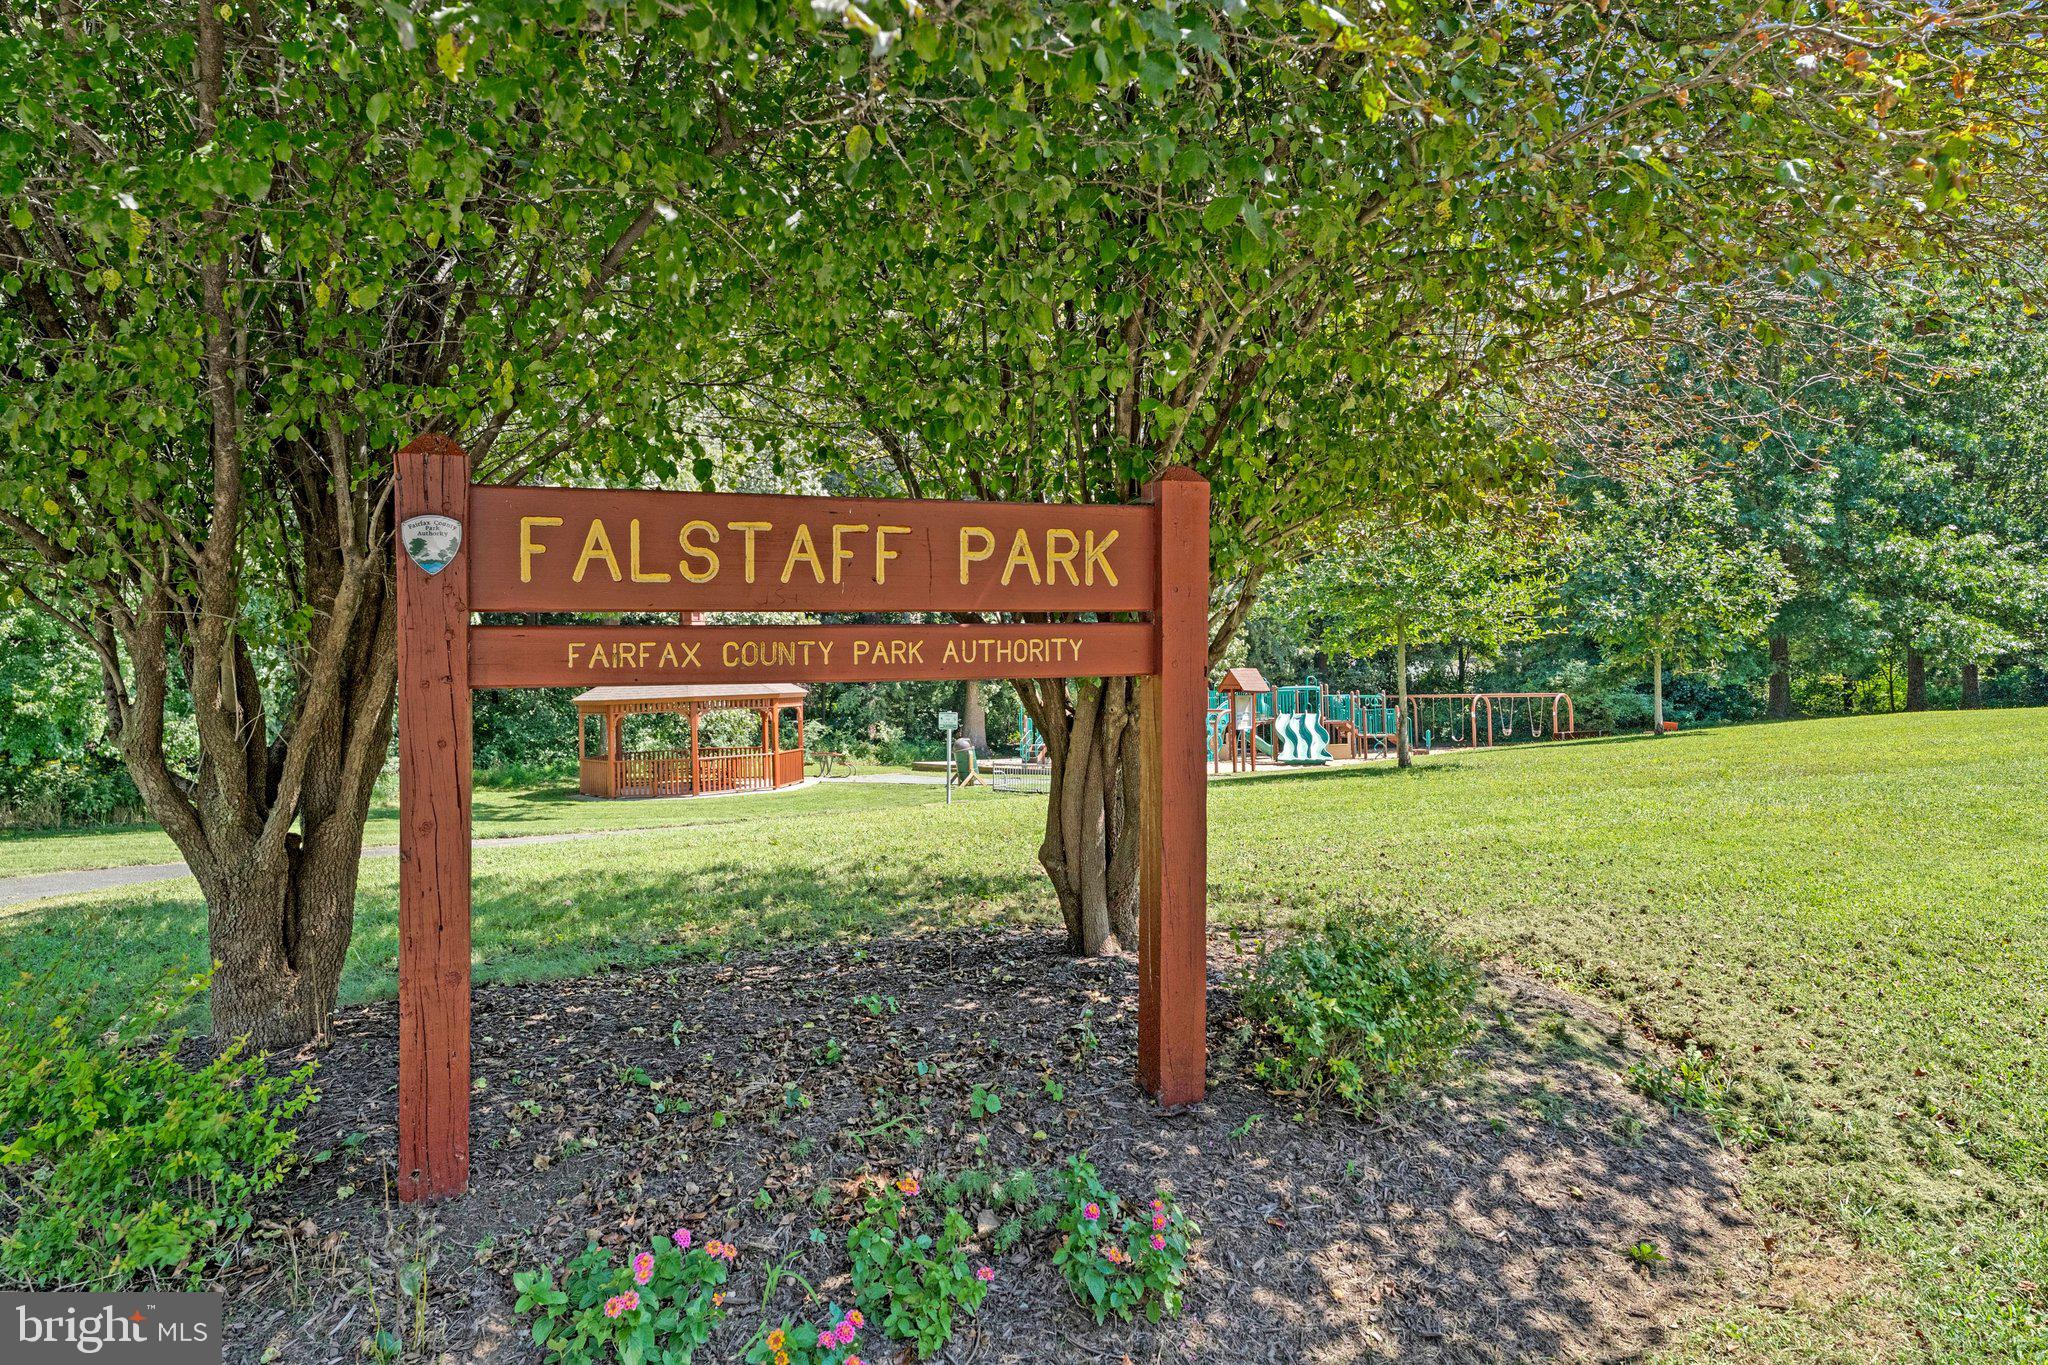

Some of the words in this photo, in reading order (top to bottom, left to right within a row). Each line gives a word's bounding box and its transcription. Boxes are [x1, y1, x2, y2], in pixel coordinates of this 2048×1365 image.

[408, 520, 430, 530] Fairfax
[433, 520, 458, 531] County
[520, 516, 912, 585] FALSTAFF
[959, 526, 1120, 587] PARK
[567, 641, 702, 669] FAIRFAX
[722, 640, 834, 667] COUNTY
[853, 640, 924, 666] PARK
[942, 638, 1084, 664] AUTHORITY
